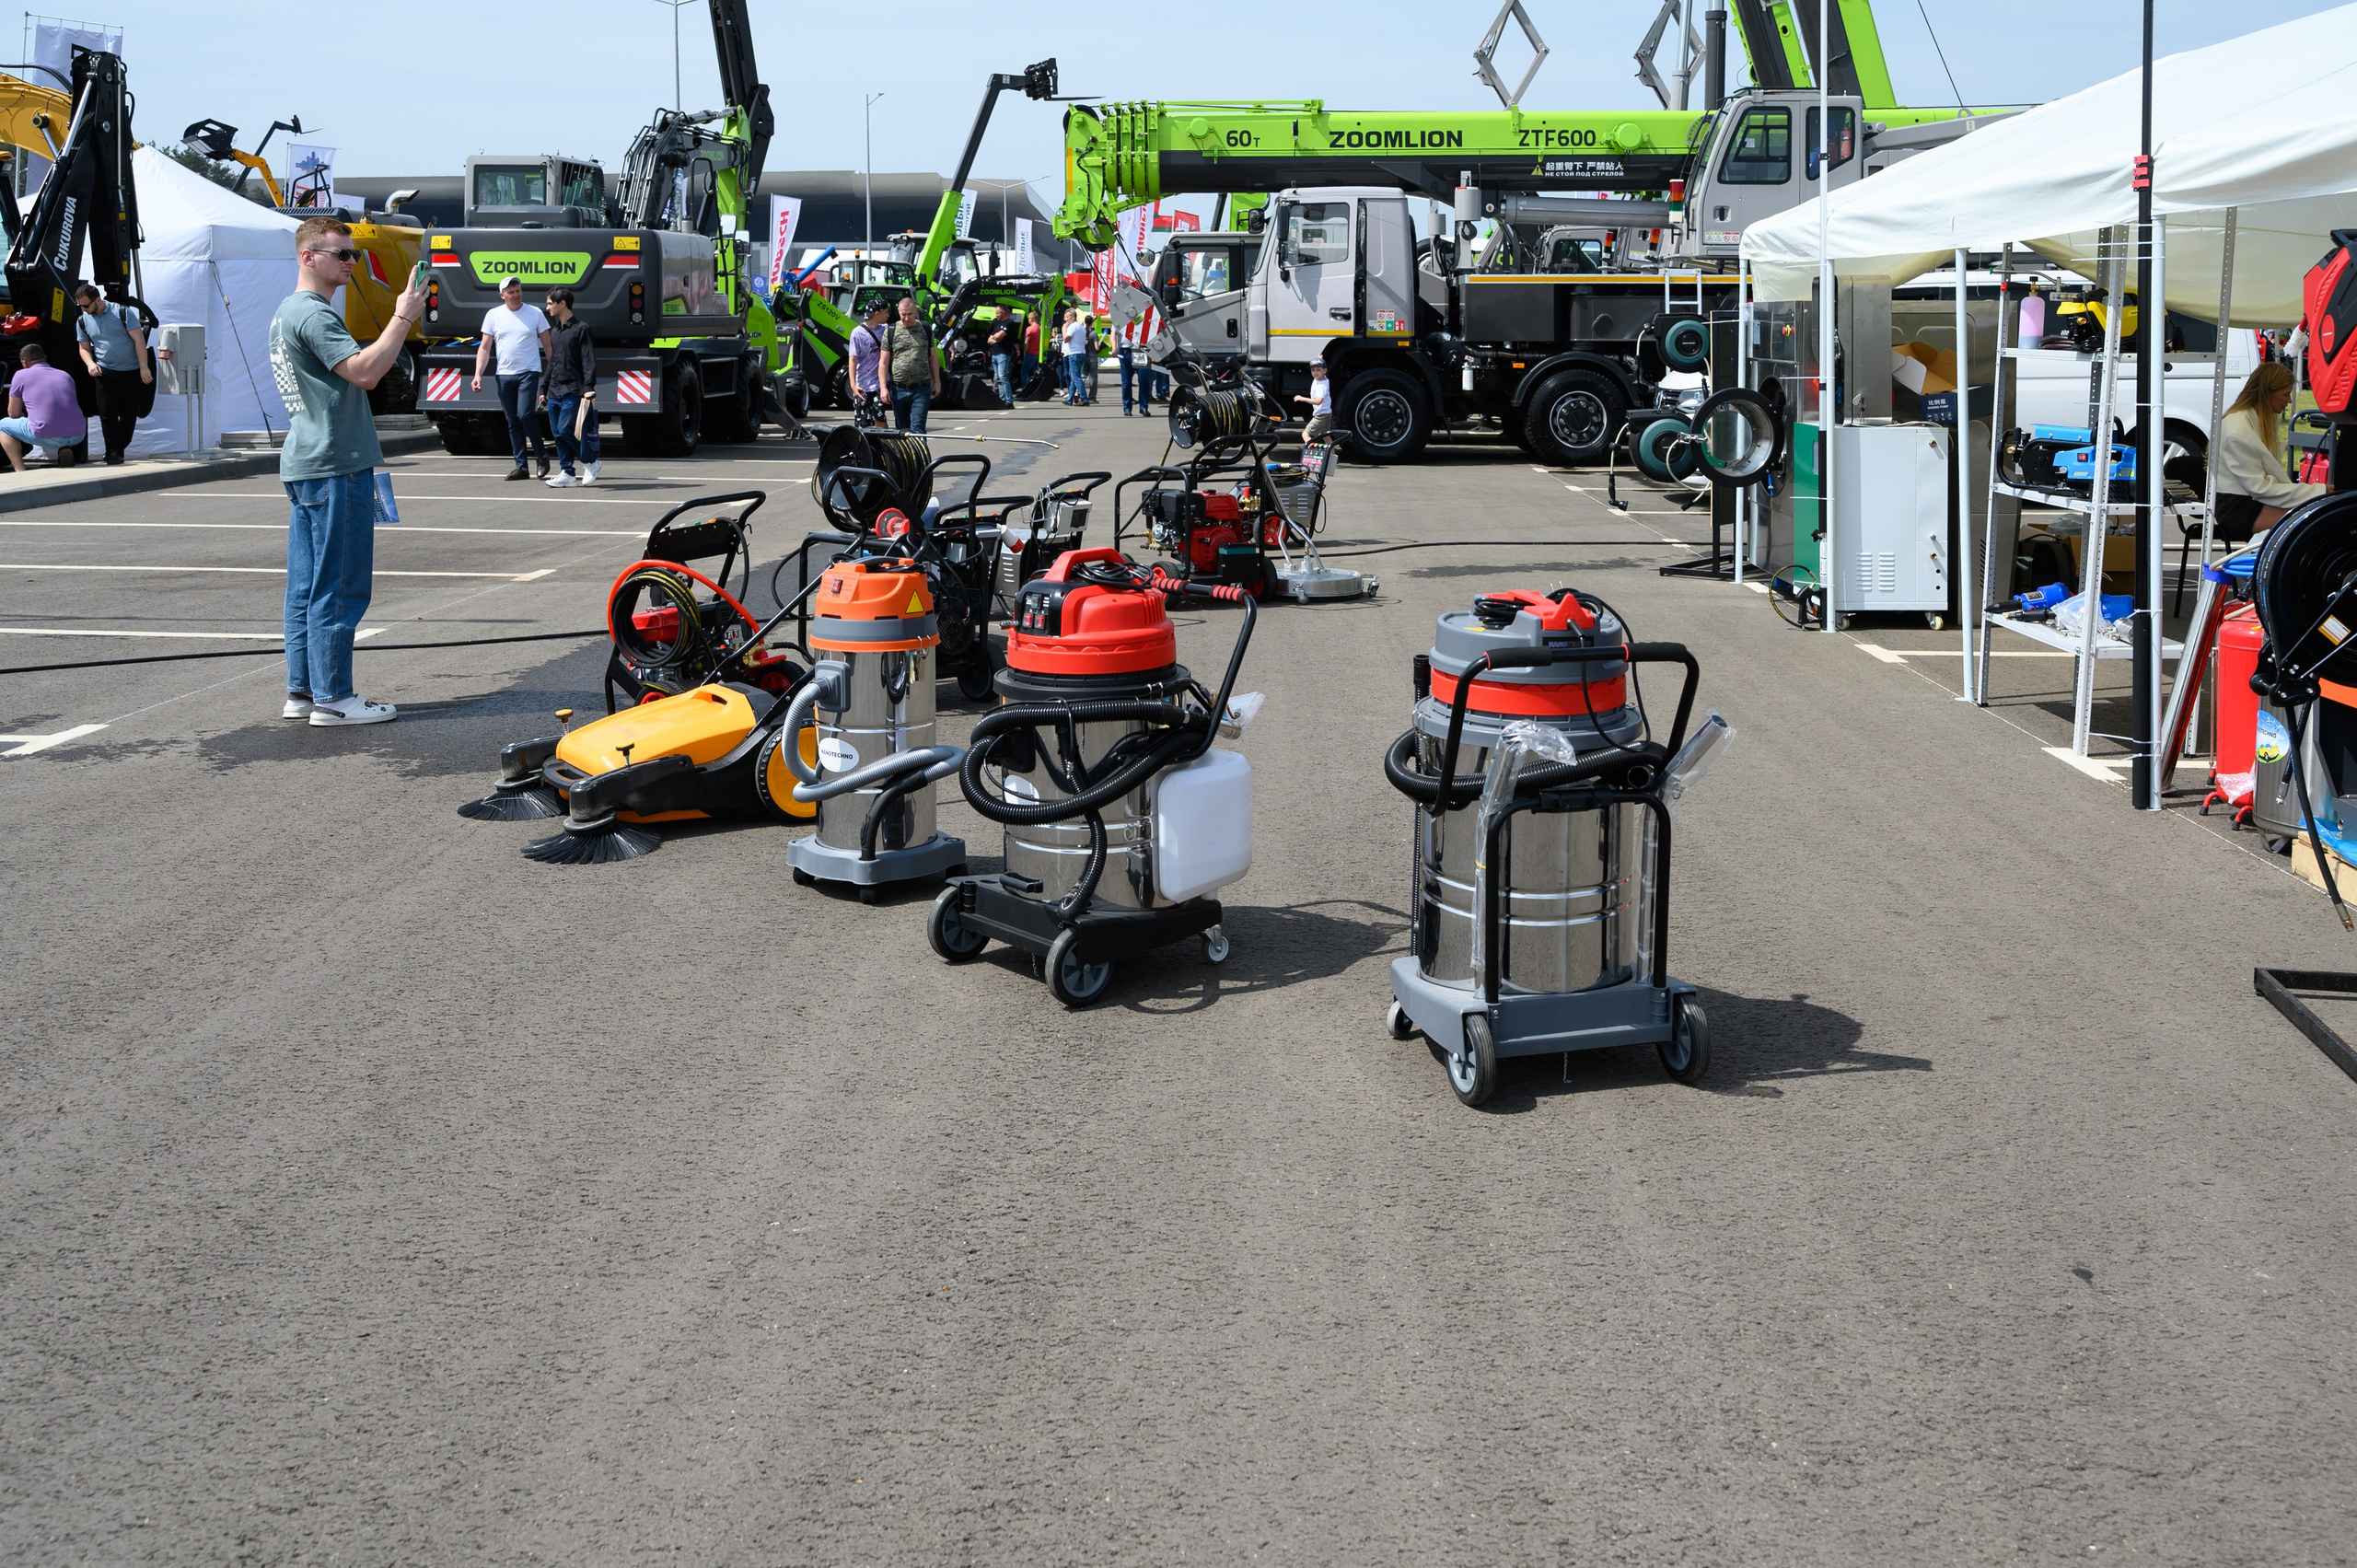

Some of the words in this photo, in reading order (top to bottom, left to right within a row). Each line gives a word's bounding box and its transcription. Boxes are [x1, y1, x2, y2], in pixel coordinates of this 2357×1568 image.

[1329, 130, 1463, 148] ZOOMLION
[1518, 129, 1596, 147] ZTF600
[1545, 161, 1583, 171] 起重臂下
[1586, 161, 1624, 171] 严禁站人
[53, 196, 77, 272] ÇUKUROVA
[482, 261, 576, 274] ZOOMLION
[817, 300, 841, 320] ZS120V
[821, 749, 853, 760] NANOTECHNO
